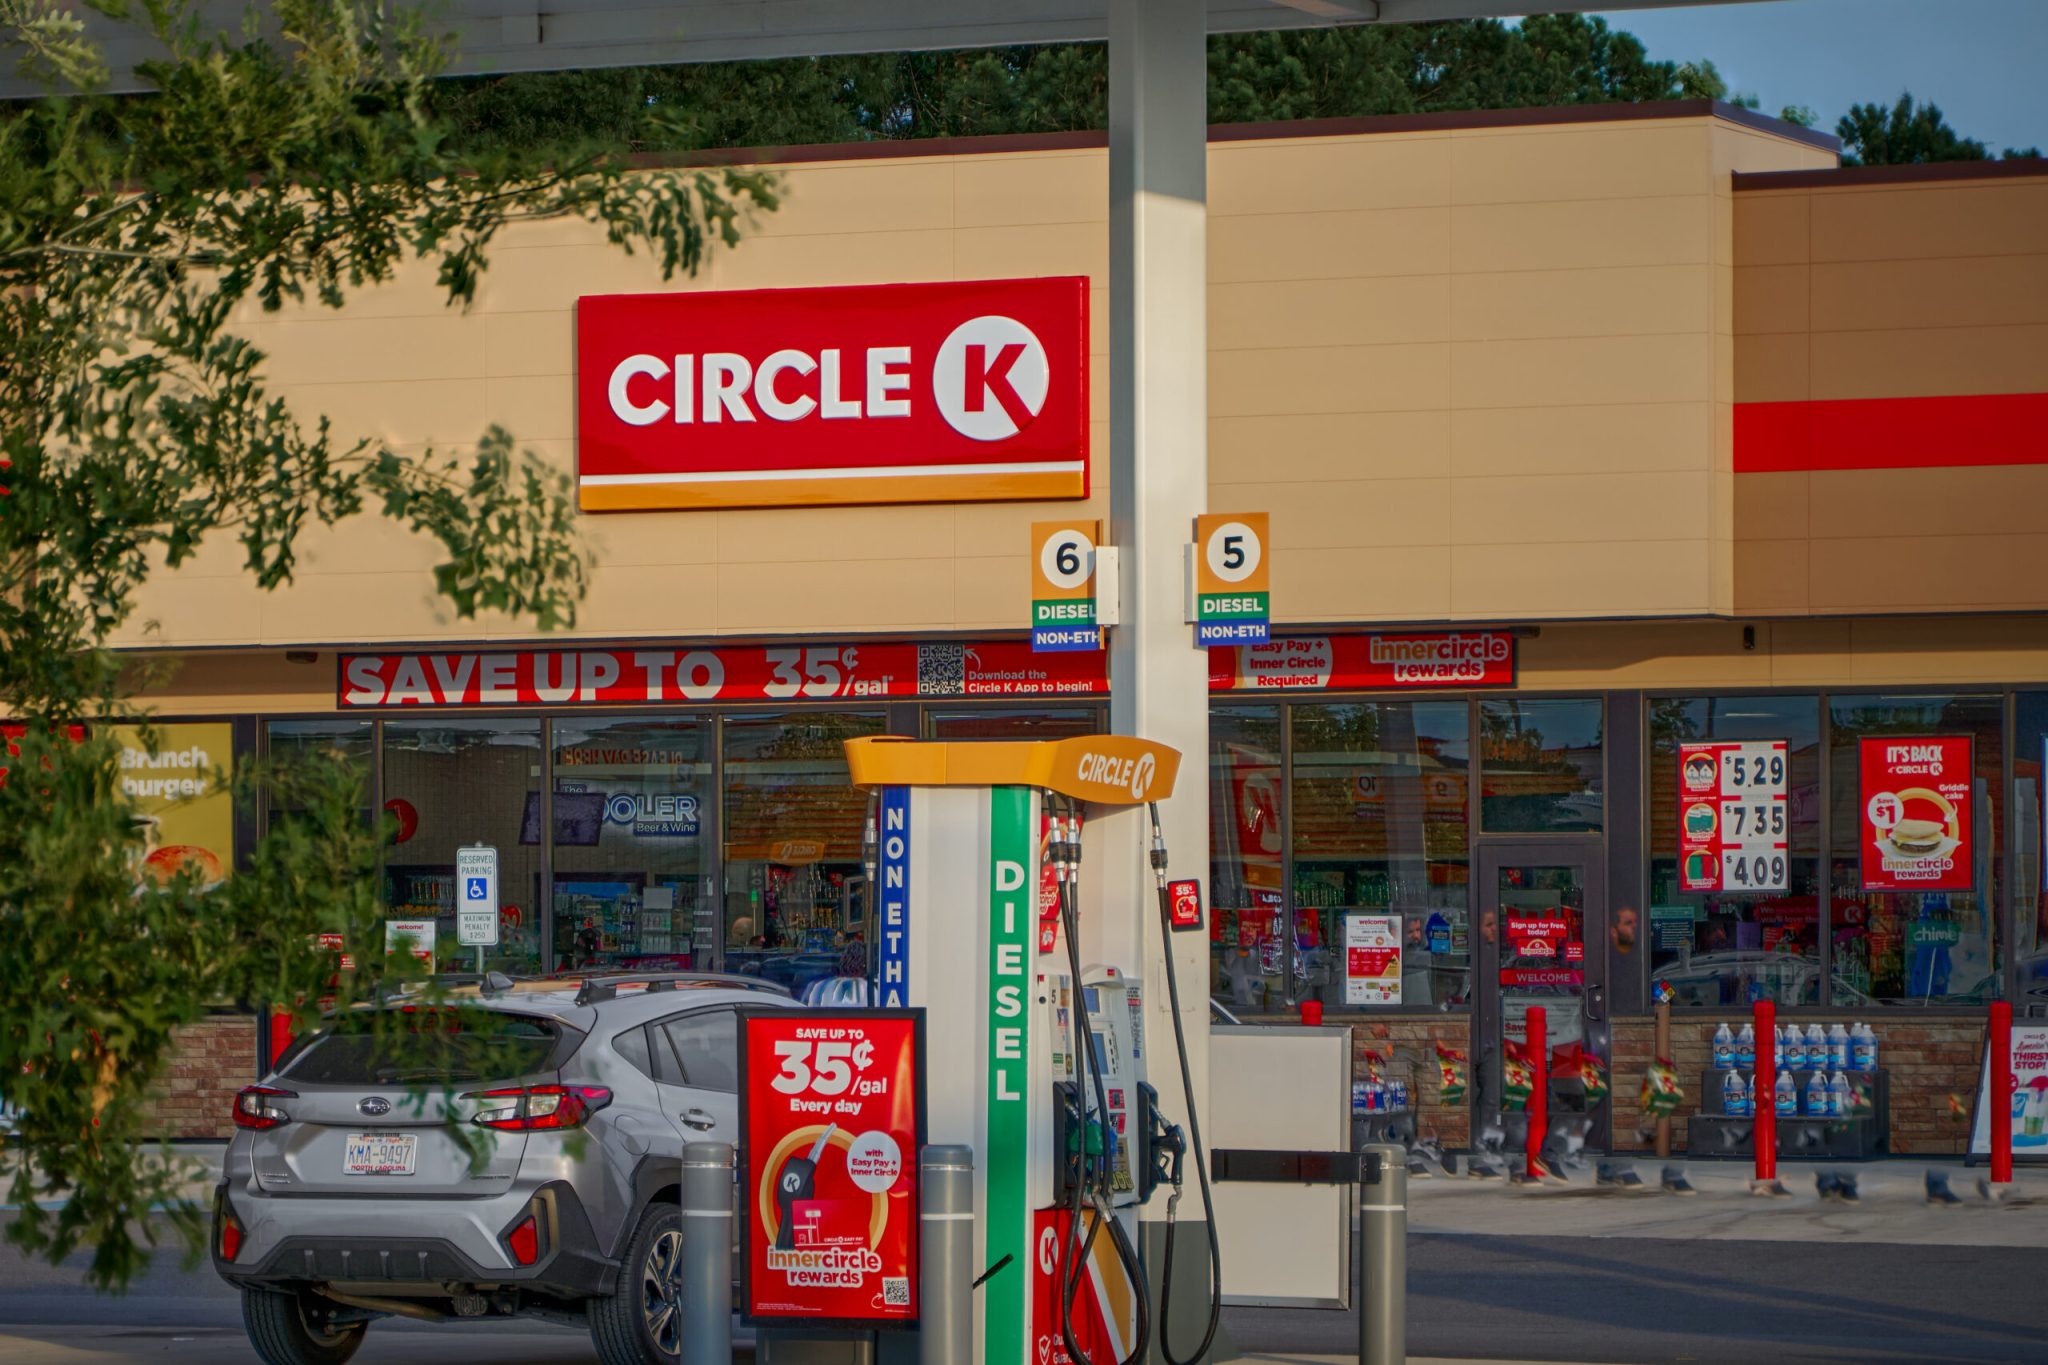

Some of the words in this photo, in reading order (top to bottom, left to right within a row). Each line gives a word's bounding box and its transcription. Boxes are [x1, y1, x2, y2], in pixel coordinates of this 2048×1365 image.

[608, 346, 912, 427] CIRCLE
[1056, 542, 1080, 575] 6
[1223, 536, 1245, 569] 5
[1038, 604, 1097, 620] DIESEL
[1203, 597, 1263, 614] DIESEL
[1036, 631, 1100, 645] NON-ETH
[1201, 624, 1266, 638] NON-ETH
[1286, 640, 1312, 653] Pay
[1372, 634, 1506, 660] innercircle
[1249, 658, 1285, 669] Inner
[1287, 656, 1326, 669] Circle
[1397, 660, 1481, 678] rewards
[345, 653, 516, 705] SAVE
[532, 652, 620, 702] UP
[634, 650, 725, 701] TO
[968, 670, 1025, 681] Download
[1028, 669, 1047, 680] the
[1257, 673, 1318, 688] Required
[968, 682, 1001, 694] Circle
[1004, 682, 1012, 693] K
[1015, 682, 1039, 694] App
[1042, 682, 1054, 693] to
[1056, 681, 1093, 694] begin!
[121, 746, 208, 769] Brunch
[1887, 746, 1910, 763] IT'S
[1911, 745, 1943, 763] BACK
[1078, 752, 1134, 788] CIRCLE
[1895, 765, 1928, 774] CIRCLE
[122, 776, 207, 800] burger
[562, 785, 583, 793] The
[1938, 783, 1969, 792] Griddle
[1944, 792, 1964, 800] cake
[603, 794, 697, 823] OLER
[1876, 804, 1896, 824] $1
[636, 822, 660, 832] Beer
[661, 822, 670, 832] &
[671, 822, 696, 832] Wine
[886, 807, 904, 888] NON
[460, 855, 493, 864] RESERVED
[1883, 857, 1952, 869] innercircle
[461, 866, 492, 875] PARKING
[1896, 869, 1940, 878] rewards
[464, 923, 490, 931] PENALTY
[1511, 922, 1527, 930] Sign
[1550, 922, 1566, 930] free,
[470, 931, 486, 939] $250
[995, 860, 1025, 1101] DIESEL
[1516, 973, 1571, 982] WELCOME
[1051, 989, 1056, 1004] 5
[796, 1028, 828, 1039] SAVE
[830, 1029, 846, 1039] UP
[848, 1030, 865, 1039] TO
[2013, 1052, 2048, 1061] THIRST
[2014, 1062, 2047, 1070] STOP!
[790, 1098, 832, 1115] Every
[835, 1098, 862, 1116] day
[347, 1144, 411, 1165] KMA-9497
[865, 1149, 883, 1157] with
[852, 1158, 872, 1167] Easy
[873, 1158, 889, 1168] Pay
[851, 1168, 872, 1176] Inner
[873, 1168, 898, 1176] Circle
[769, 1249, 879, 1269] innercircle
[790, 1270, 860, 1284] rewards
